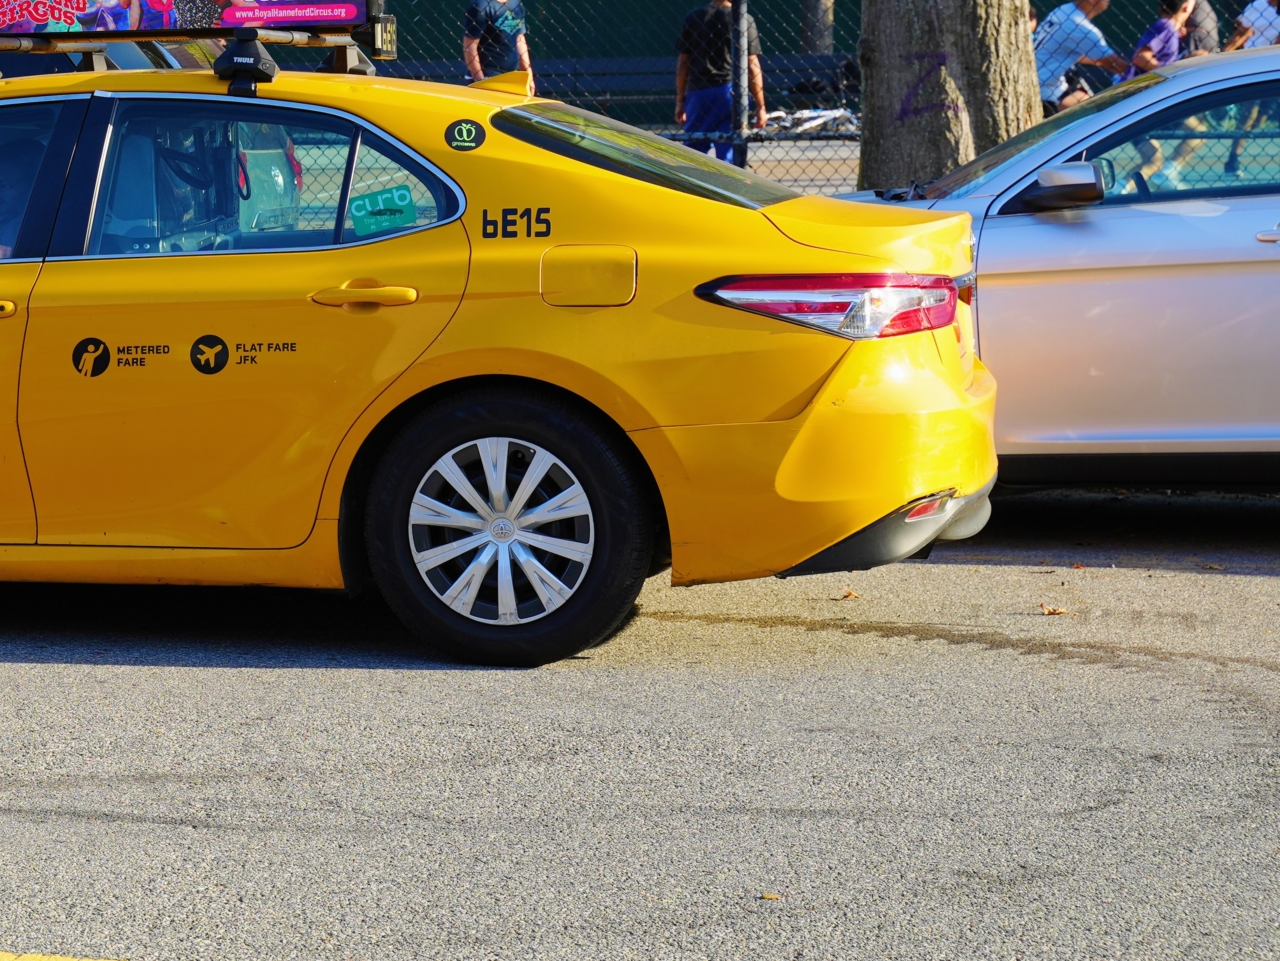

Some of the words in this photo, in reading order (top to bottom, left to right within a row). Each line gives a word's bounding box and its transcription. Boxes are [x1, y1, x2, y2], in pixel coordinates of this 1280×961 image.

[235, 8, 346, 20] www.RoyalHannefordCircus.org
[351, 189, 411, 216] curb
[117, 345, 170, 355] METERED
[236, 343, 264, 353] FLAT
[267, 342, 297, 352] FARE
[117, 358, 146, 367] FARE
[236, 355, 258, 365] JFK
